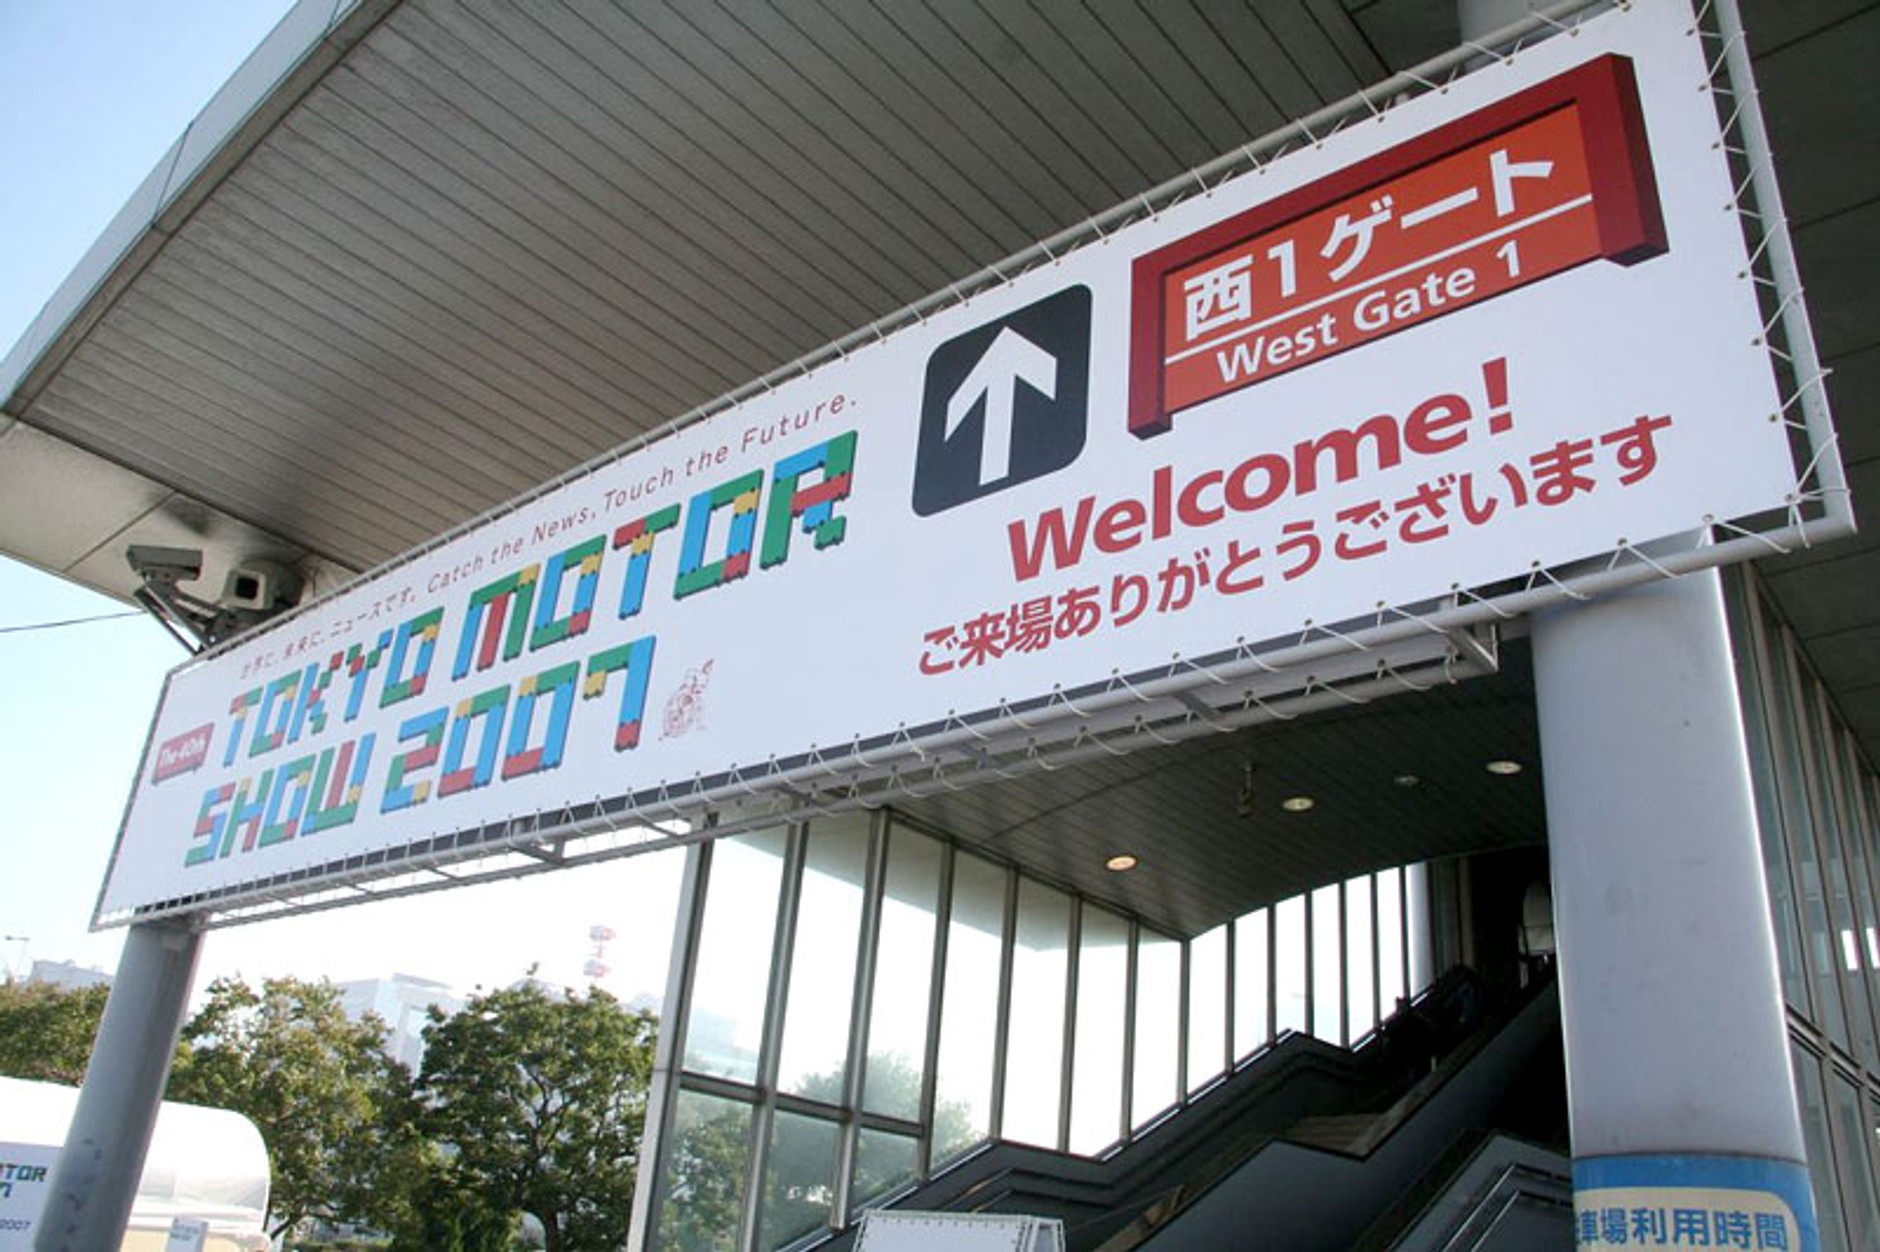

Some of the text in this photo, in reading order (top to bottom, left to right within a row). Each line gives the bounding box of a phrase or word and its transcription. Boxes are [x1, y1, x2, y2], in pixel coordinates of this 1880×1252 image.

[1216, 239, 1520, 384] West Gate 1
[427, 393, 857, 594] Catch the News, Touch the Future.
[919, 415, 1674, 676] ご来場ありがとうございます
[1007, 357, 1514, 582] Welcome!
[224, 430, 858, 768] TOKYO MOTOR
[184, 635, 656, 867] SHOW 2007
[0, 1163, 47, 1182] TOR
[1577, 1207, 1787, 1251] 車場利用時間
